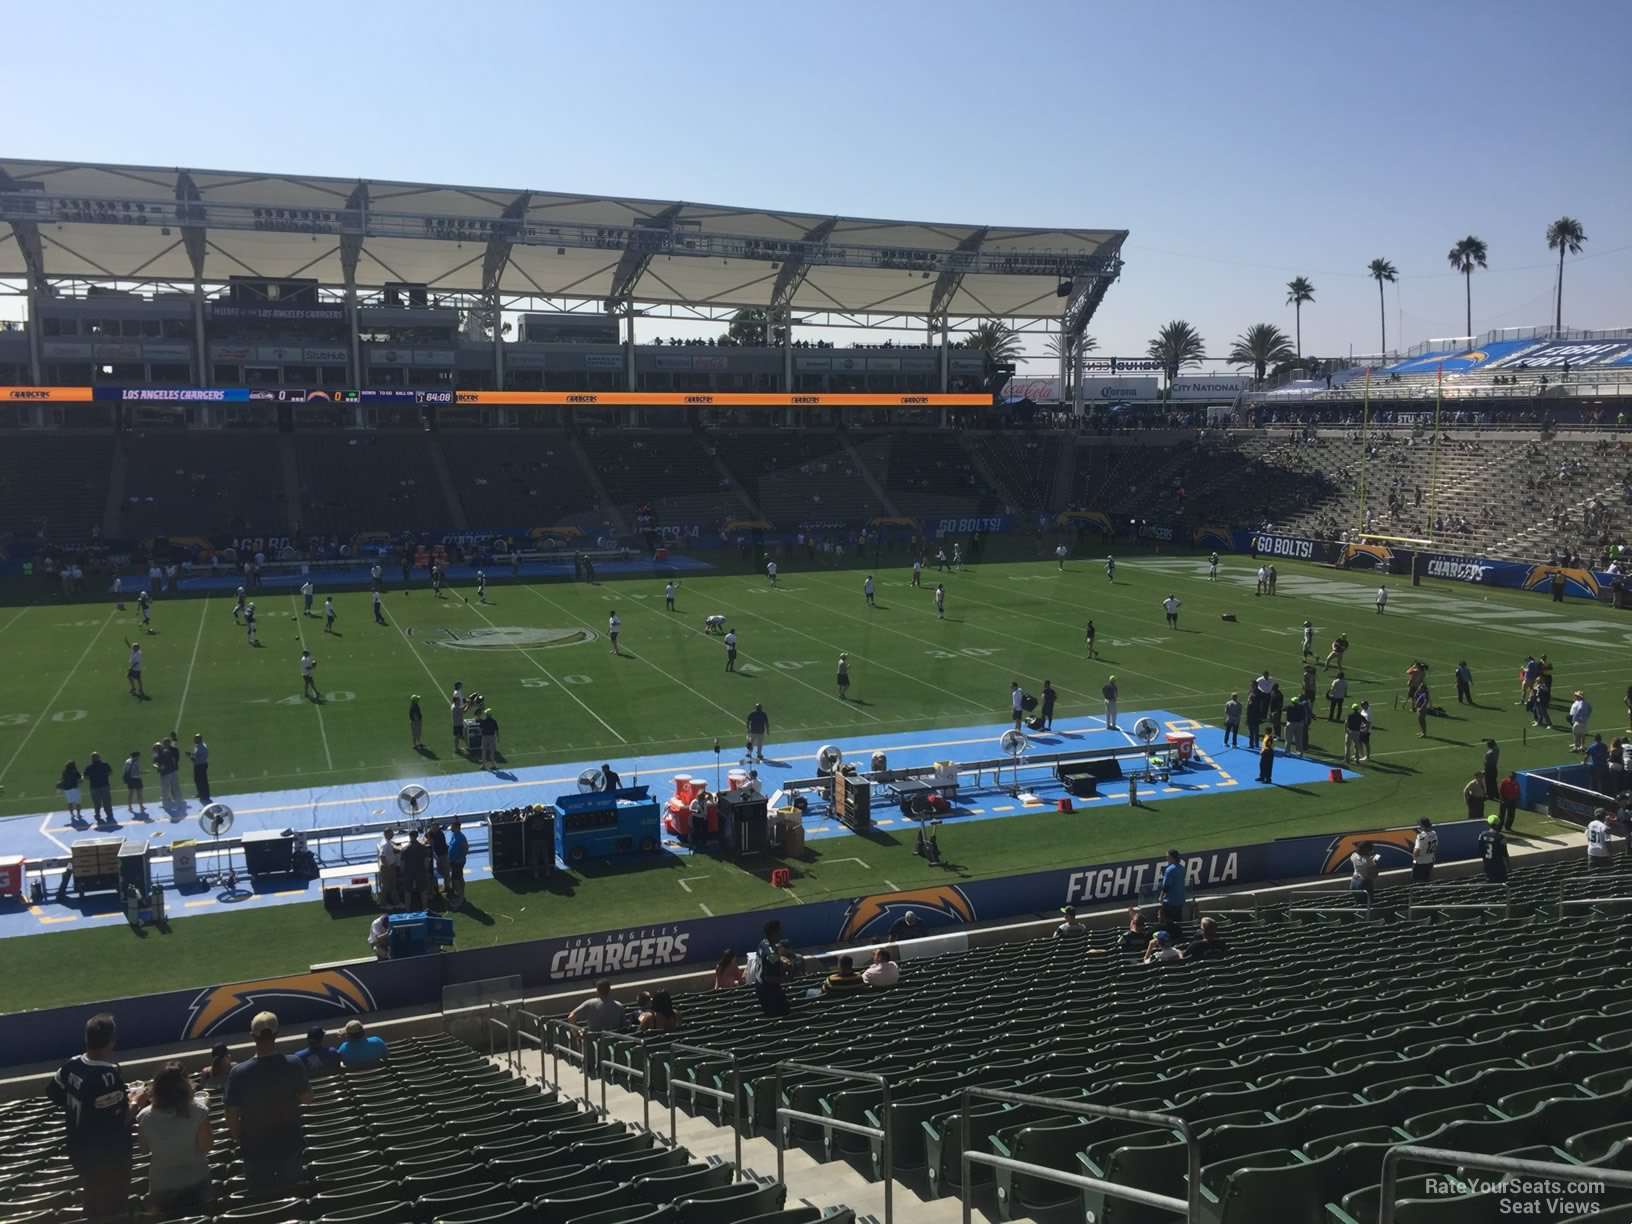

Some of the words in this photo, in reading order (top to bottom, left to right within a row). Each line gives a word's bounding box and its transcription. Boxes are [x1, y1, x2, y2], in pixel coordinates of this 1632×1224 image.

[306, 351, 345, 360] StubHub
[1101, 387, 1137, 398] Corona
[1192, 383, 1240, 392] NATIONAL
[122, 390, 139, 400] LOS
[140, 390, 179, 400] ANGELES
[180, 391, 224, 400] CHARGERS
[426, 392, 451, 402] 64:08
[939, 519, 958, 533] GO
[958, 518, 1001, 532] BOLTS!
[1257, 536, 1273, 552] GO
[1273, 539, 1313, 558] BOLTS!
[739, 660, 805, 673] 40
[520, 674, 593, 687] 50
[1180, 742, 1191, 753] G
[1426, 839, 1437, 854] 12
[1485, 843, 1493, 859] 3
[775, 873, 790, 887] 50
[1066, 864, 1149, 903] FIGHT
[1152, 857, 1203, 892] FR
[1208, 852, 1238, 884] LA
[565, 938, 592, 949] LOS
[606, 926, 678, 944] ANGELES
[550, 933, 690, 979] CHARGERS
[102, 1072, 115, 1087] 17
